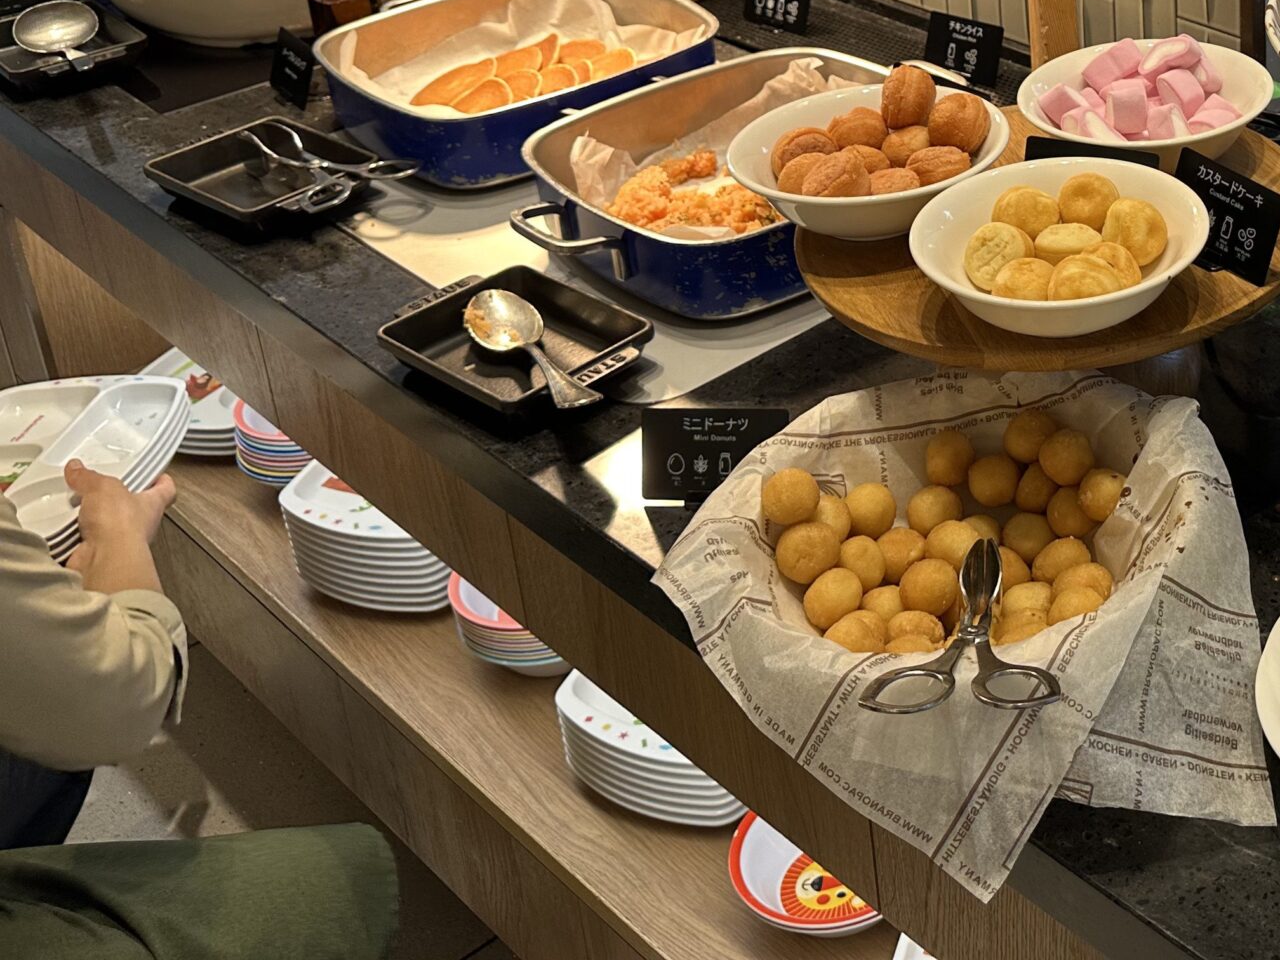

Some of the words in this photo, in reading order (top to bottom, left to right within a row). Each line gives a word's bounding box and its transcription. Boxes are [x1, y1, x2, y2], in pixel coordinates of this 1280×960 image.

[1196, 164, 1264, 208] カスタードケーキ
[1209, 187, 1230, 204] Custard
[1230, 198, 1244, 212] Cake
[576, 352, 628, 385] STAU
[682, 416, 749, 431] ミニドーナツ
[693, 433, 709, 442] Mini
